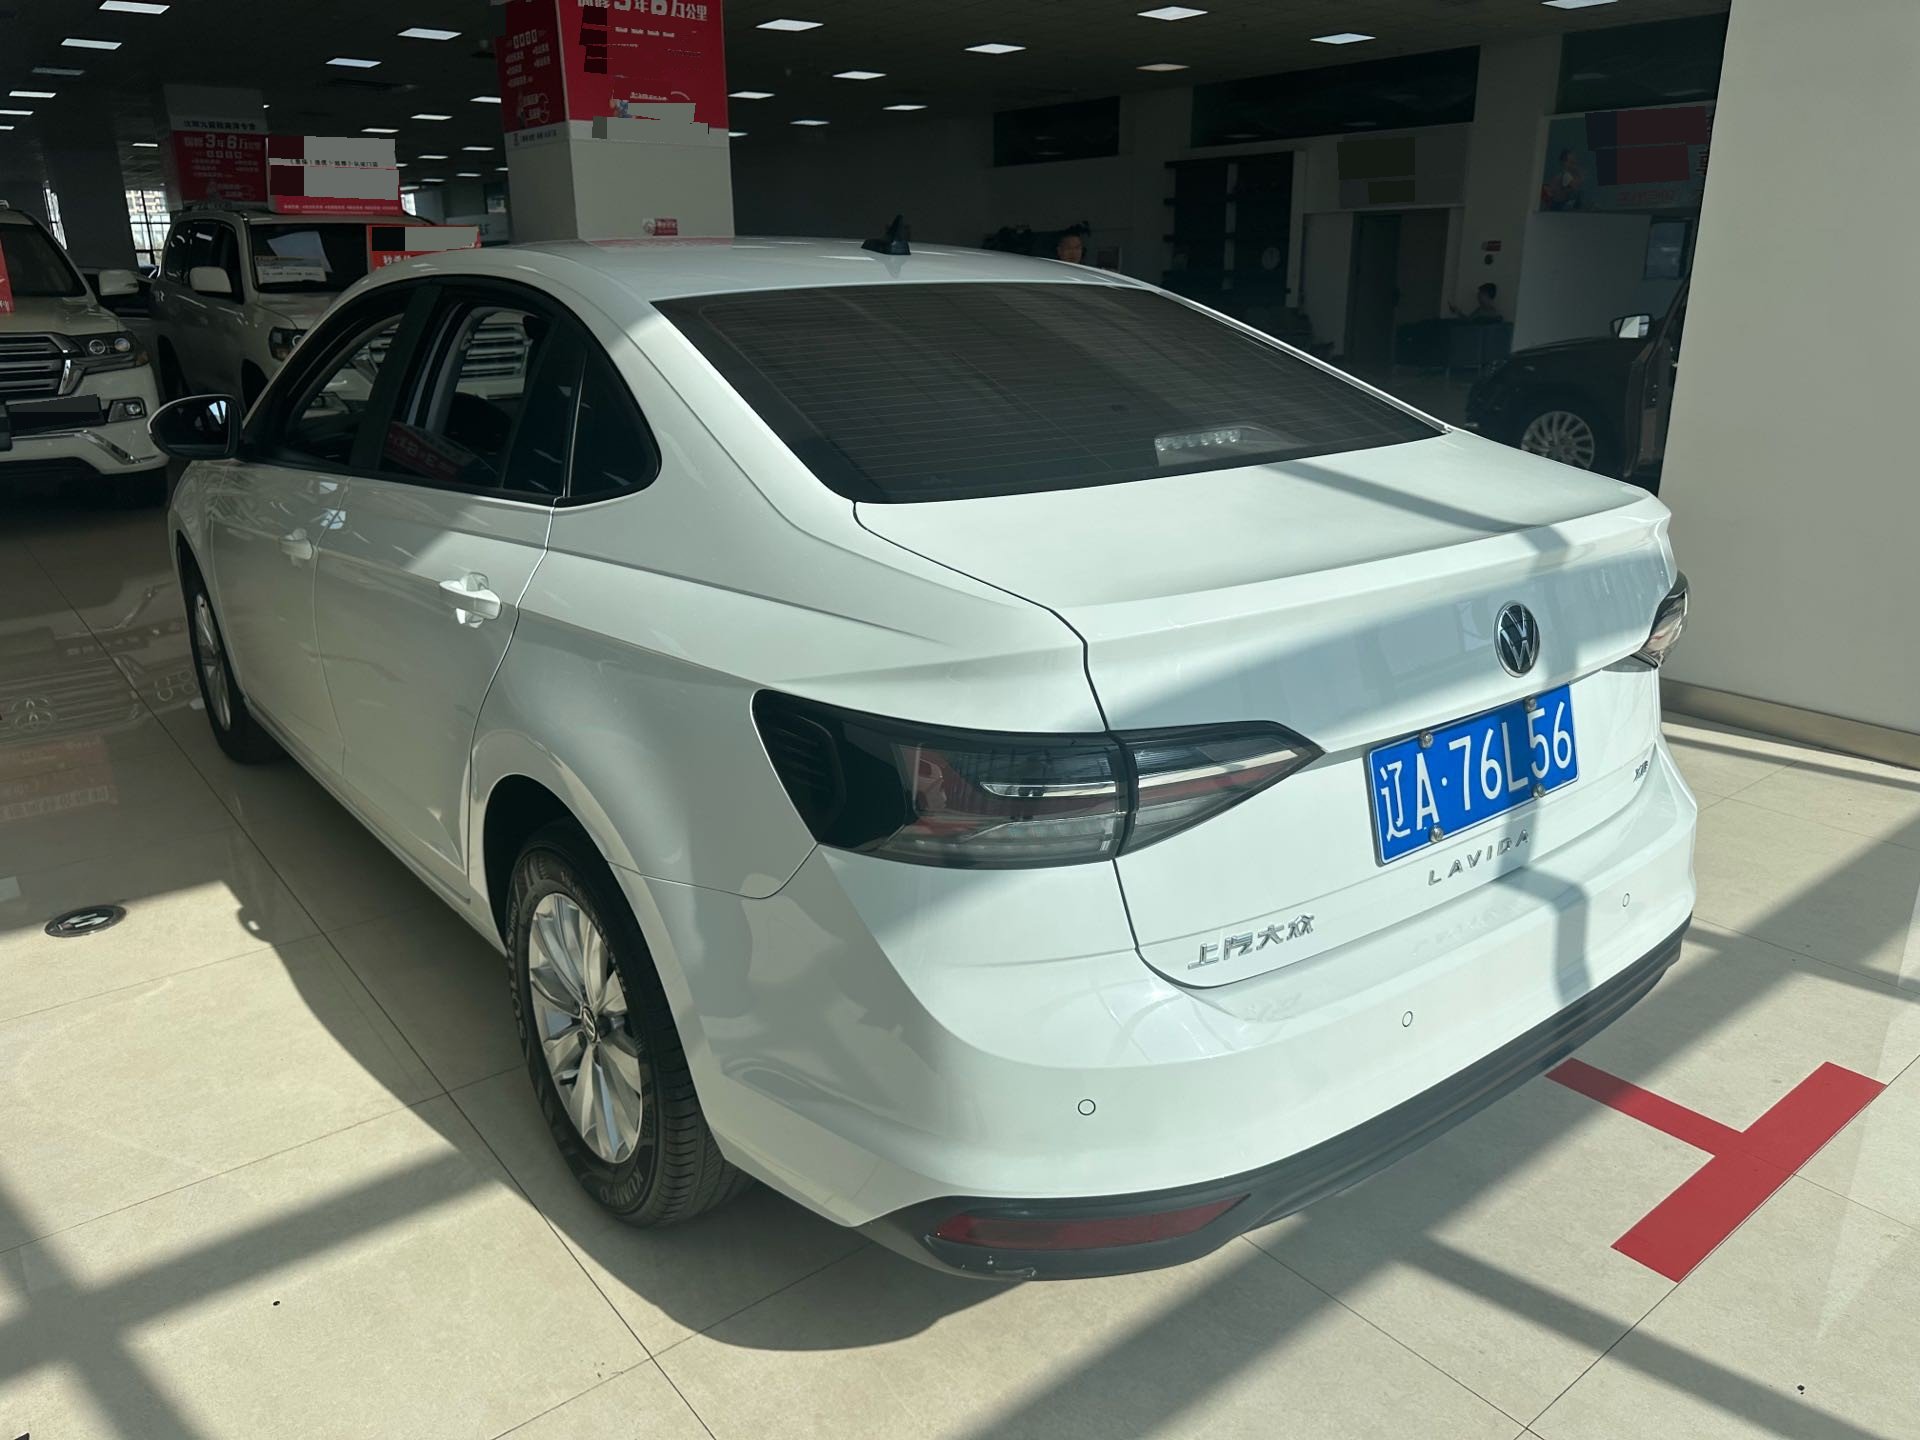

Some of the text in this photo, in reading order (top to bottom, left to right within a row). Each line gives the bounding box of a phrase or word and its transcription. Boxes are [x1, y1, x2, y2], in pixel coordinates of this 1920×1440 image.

[1380, 701, 1572, 842] 辽A·76L56
[1427, 828, 1530, 886] LAVIDA
[1187, 913, 1316, 970] 上汽大众
